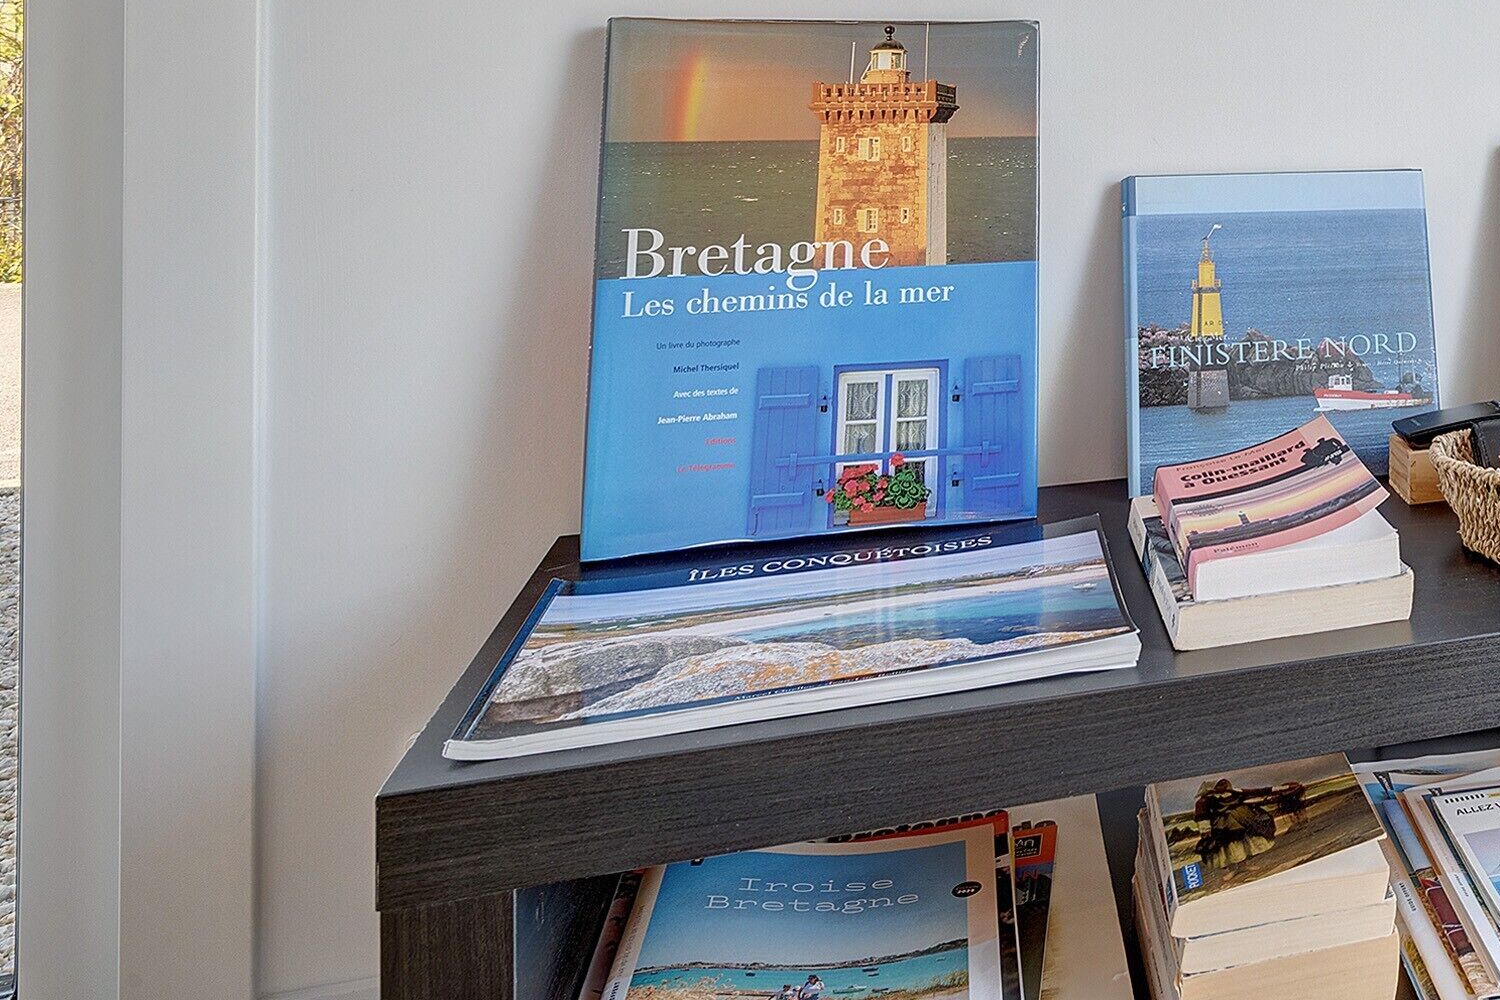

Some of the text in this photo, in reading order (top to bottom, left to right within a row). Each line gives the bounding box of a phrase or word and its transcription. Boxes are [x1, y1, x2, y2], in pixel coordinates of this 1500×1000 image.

[619, 227, 890, 291] Bretagne
[621, 279, 955, 319] Les chemins de la mer
[656, 338, 741, 350] Un livre du photographe
[1321, 331, 1417, 358] NORD
[673, 363, 740, 374] Michel Thersiquel
[673, 387, 739, 398] Avec des textes de
[656, 412, 738, 425] Jean-Pierre Abraham
[1180, 440, 1307, 482] Colin-maillard
[1183, 456, 1289, 489] à Ouessant
[687, 562, 755, 583] ÎLES
[1456, 803, 1495, 816] ALLEZ
[738, 876, 895, 894] Iroise
[703, 891, 920, 915] Bretagne
